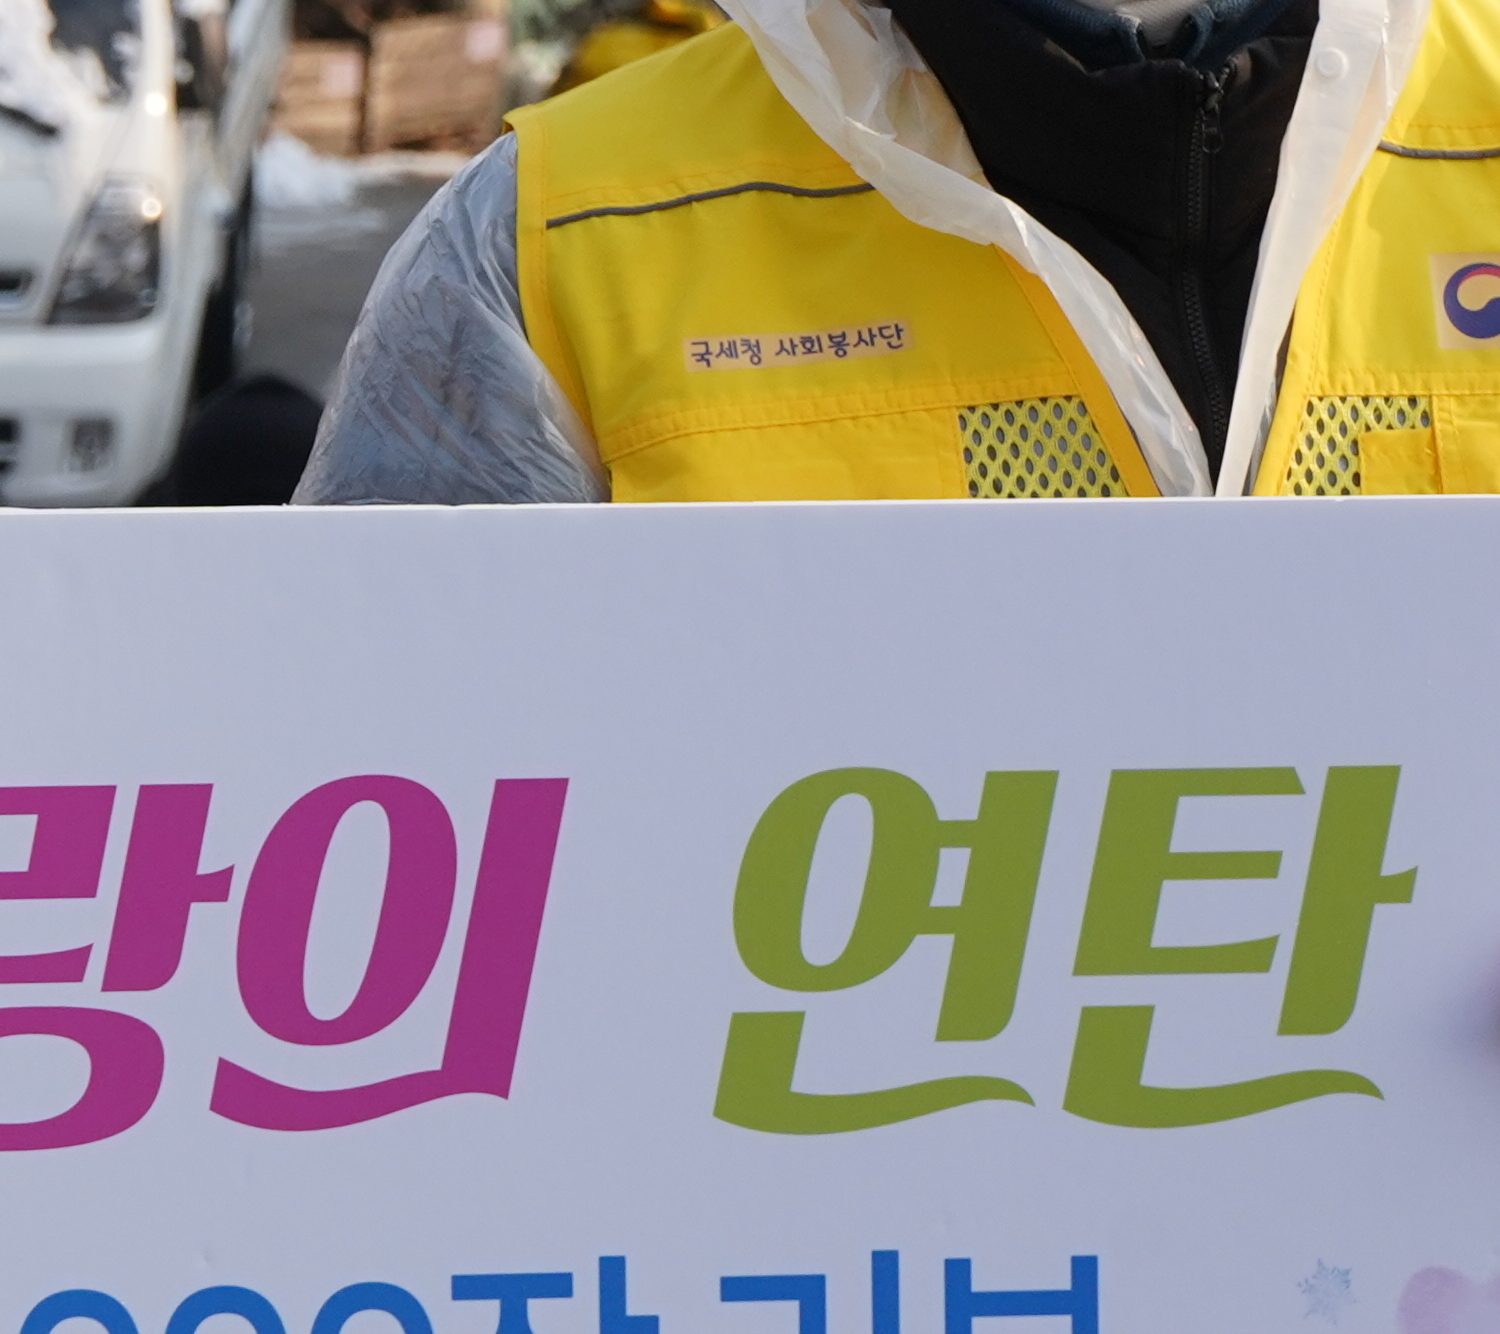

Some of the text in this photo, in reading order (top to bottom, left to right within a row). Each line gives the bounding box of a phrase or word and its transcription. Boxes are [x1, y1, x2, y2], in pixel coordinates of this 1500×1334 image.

[690, 323, 904, 368] 국세청 사회봉사단
[713, 765, 1419, 1136] 연탄
